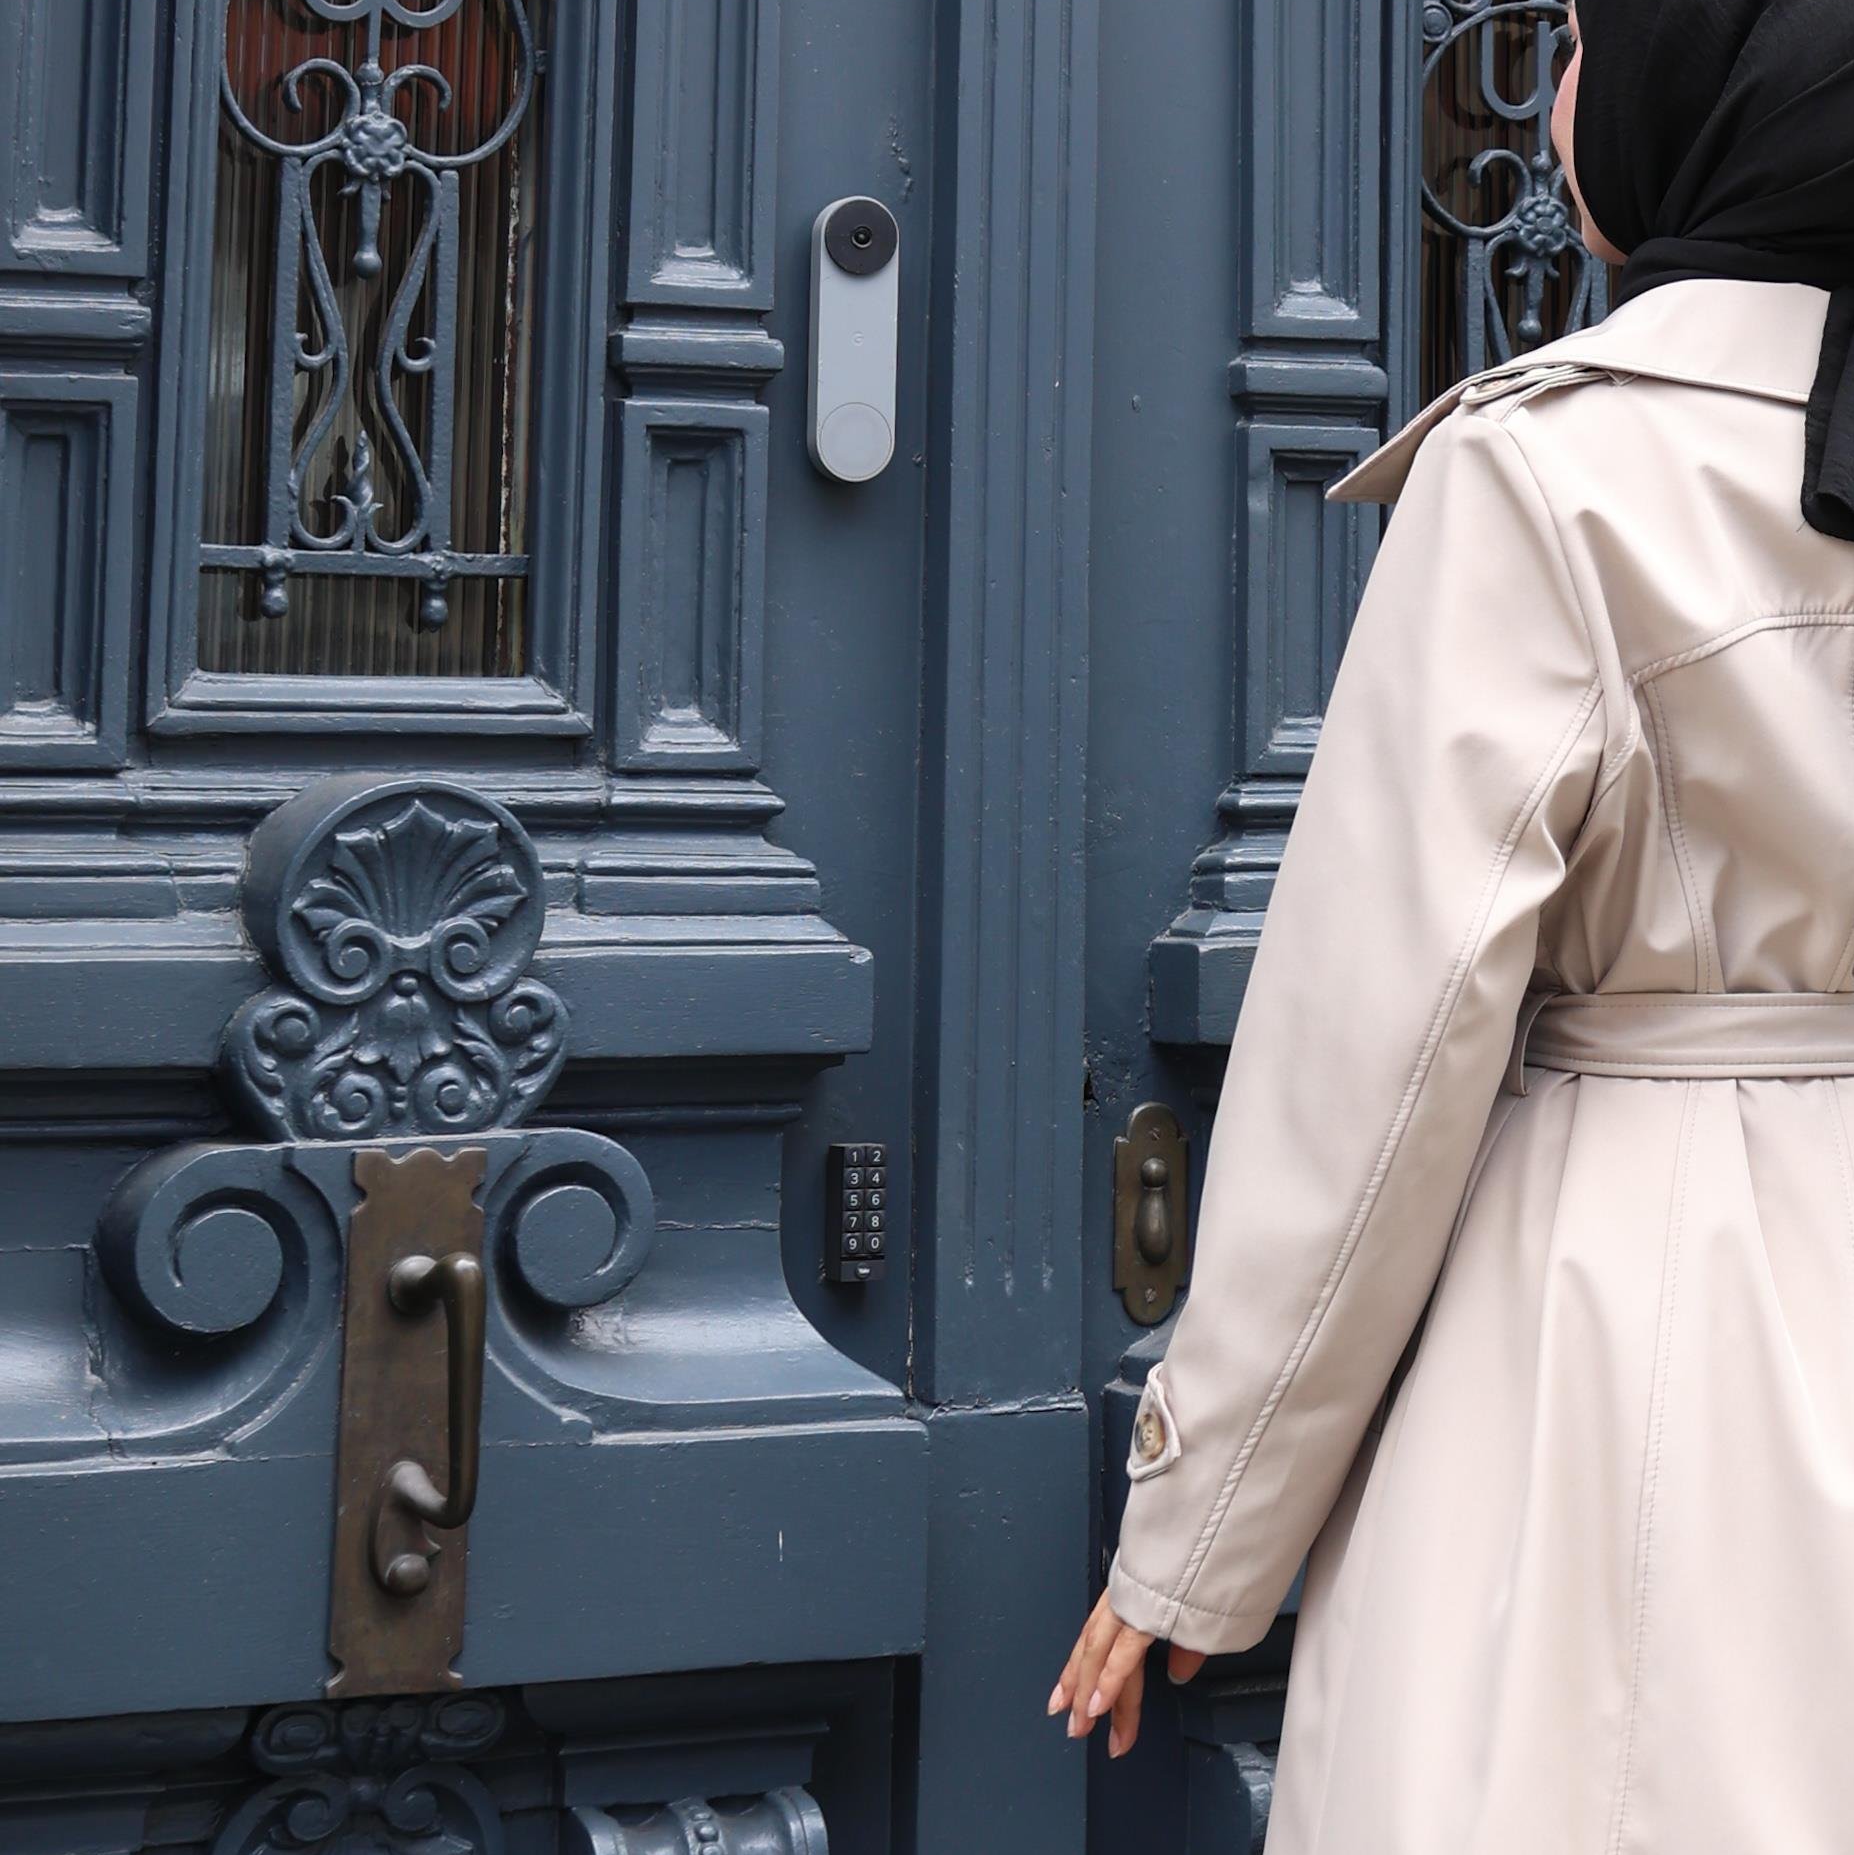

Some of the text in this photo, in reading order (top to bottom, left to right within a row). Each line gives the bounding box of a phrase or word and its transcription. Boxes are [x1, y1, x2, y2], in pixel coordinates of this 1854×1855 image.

[852, 1150, 881, 1163] 1 2
[850, 1172, 880, 1185] 3 4
[850, 1193, 880, 1206] 5 6
[849, 1215, 880, 1228] 7 8
[848, 1237, 880, 1250] 9 0
